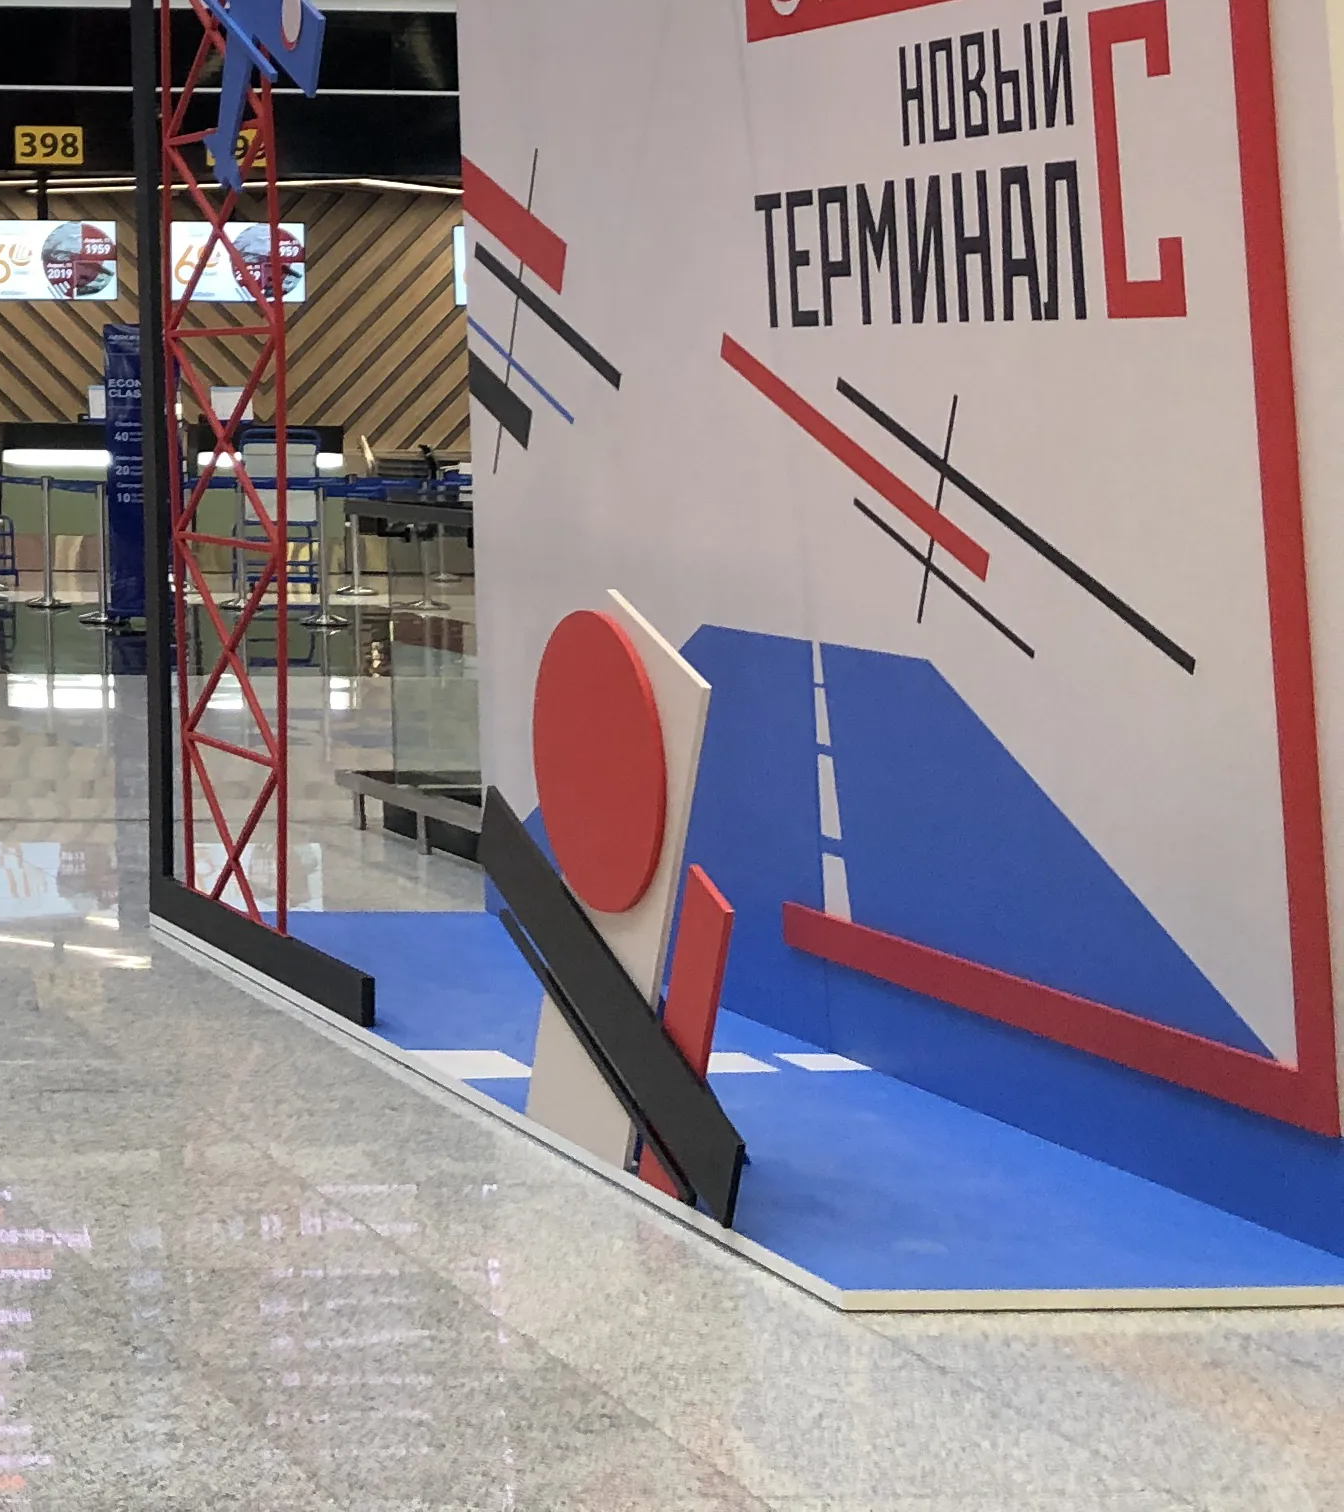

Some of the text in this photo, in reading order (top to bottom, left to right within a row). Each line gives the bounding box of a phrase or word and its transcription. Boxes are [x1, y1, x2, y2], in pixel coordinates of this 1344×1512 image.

[899, 0, 1074, 147] НОВЫЙ
[19, 132, 79, 158] 398
[754, 160, 1087, 328] ТЕРМИНАЛ
[108, 379, 141, 388] ECON
[108, 389, 142, 398] CLAS
[114, 432, 129, 441] 40
[115, 466, 130, 475] 20
[116, 493, 130, 502] 10
